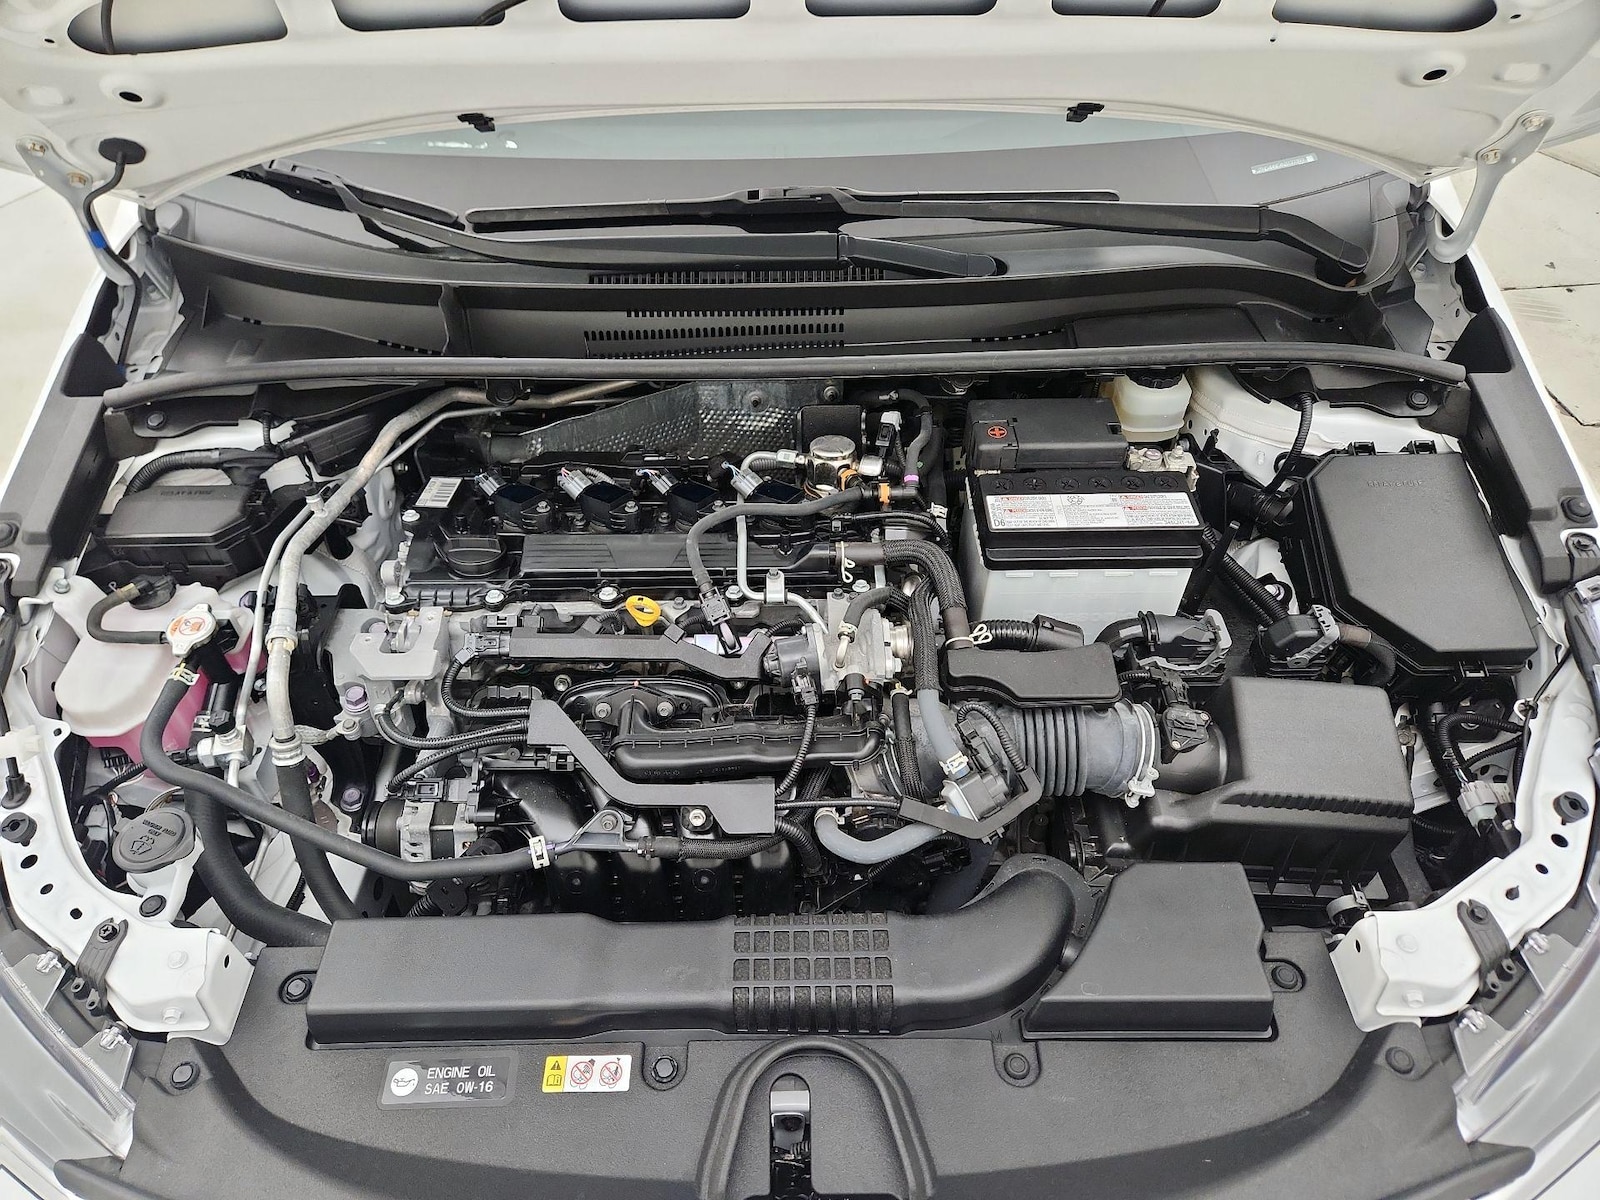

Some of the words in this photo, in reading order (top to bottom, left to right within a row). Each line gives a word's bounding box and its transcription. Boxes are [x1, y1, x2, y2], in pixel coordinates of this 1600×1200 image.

[426, 1066, 471, 1079] ENGINE
[478, 1065, 496, 1077] OIL
[424, 1082, 449, 1095] SAE
[456, 1081, 493, 1094] 0W-16
